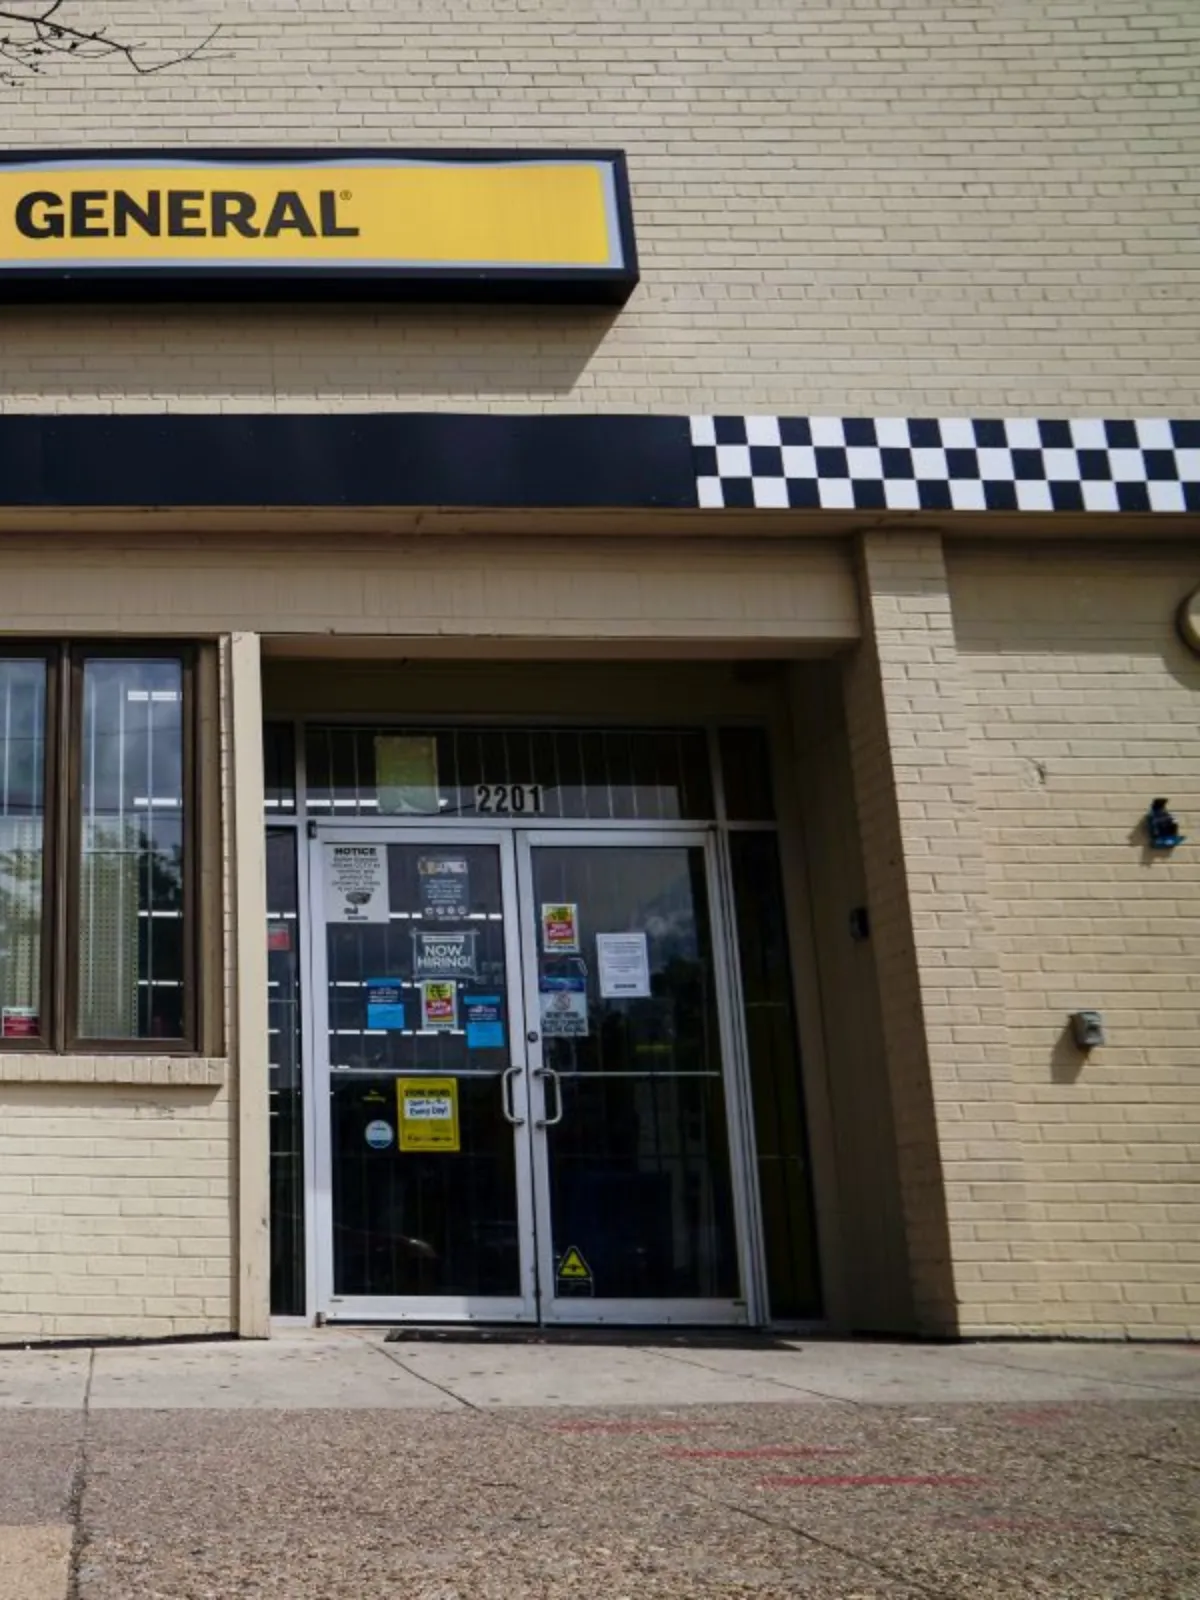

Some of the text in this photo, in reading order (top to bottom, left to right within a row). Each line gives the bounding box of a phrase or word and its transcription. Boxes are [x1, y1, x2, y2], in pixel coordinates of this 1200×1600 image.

[15, 190, 360, 239] GENERAL
[477, 785, 540, 812] 2201
[333, 847, 377, 857] NOTICE
[424, 944, 462, 956] NOW
[417, 955, 471, 969] HIRING!
